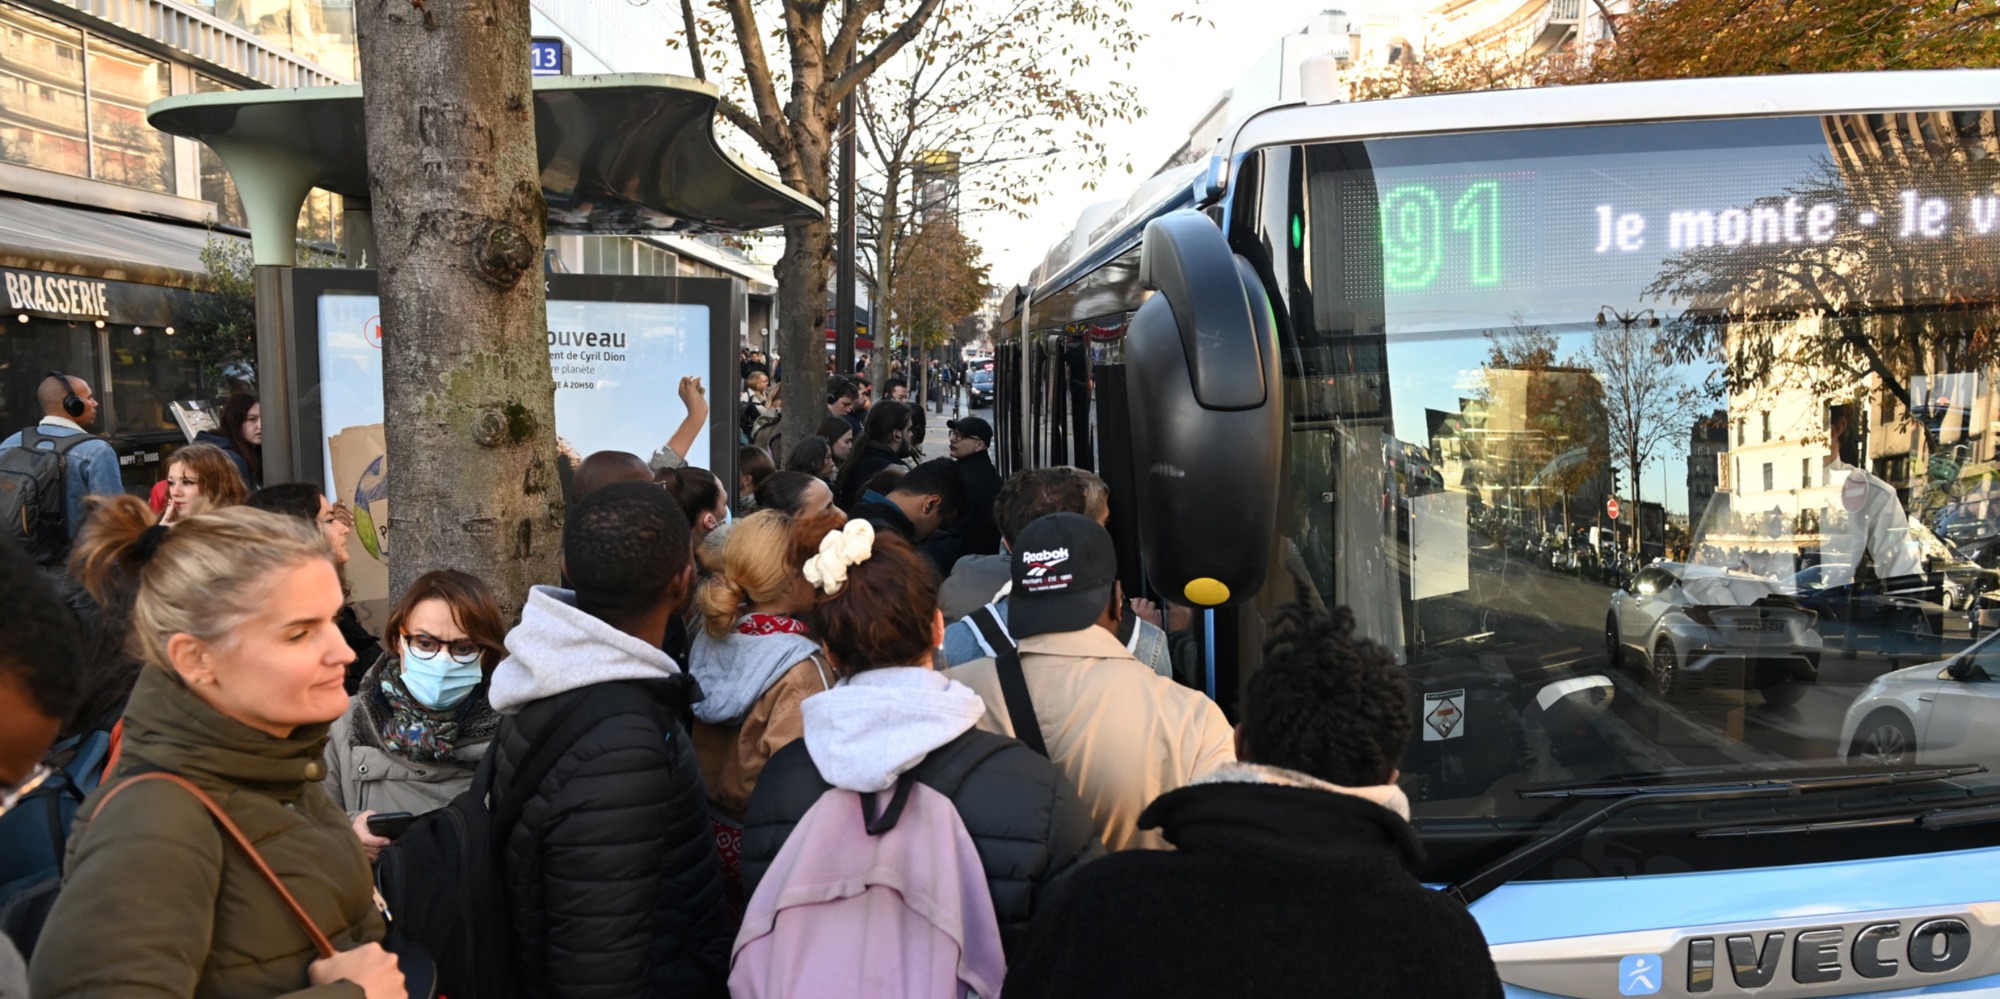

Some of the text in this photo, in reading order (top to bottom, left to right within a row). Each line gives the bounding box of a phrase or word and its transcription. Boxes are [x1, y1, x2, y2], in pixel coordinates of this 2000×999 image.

[531, 48, 557, 67] 13
[1596, 205, 1645, 252] Je
[1669, 197, 1836, 248] monte
[1900, 191, 1946, 237] Je
[1381, 182, 1499, 288] 91
[5, 271, 110, 317] BRASSERIE
[566, 351, 578, 360] de
[580, 351, 601, 363] Cyril
[603, 352, 626, 361] Dion
[562, 365, 595, 375] planète
[563, 380, 569, 388] À
[570, 381, 594, 389] 20H50
[1023, 547, 1069, 564] Reebok
[1687, 917, 1972, 993] IVECO
